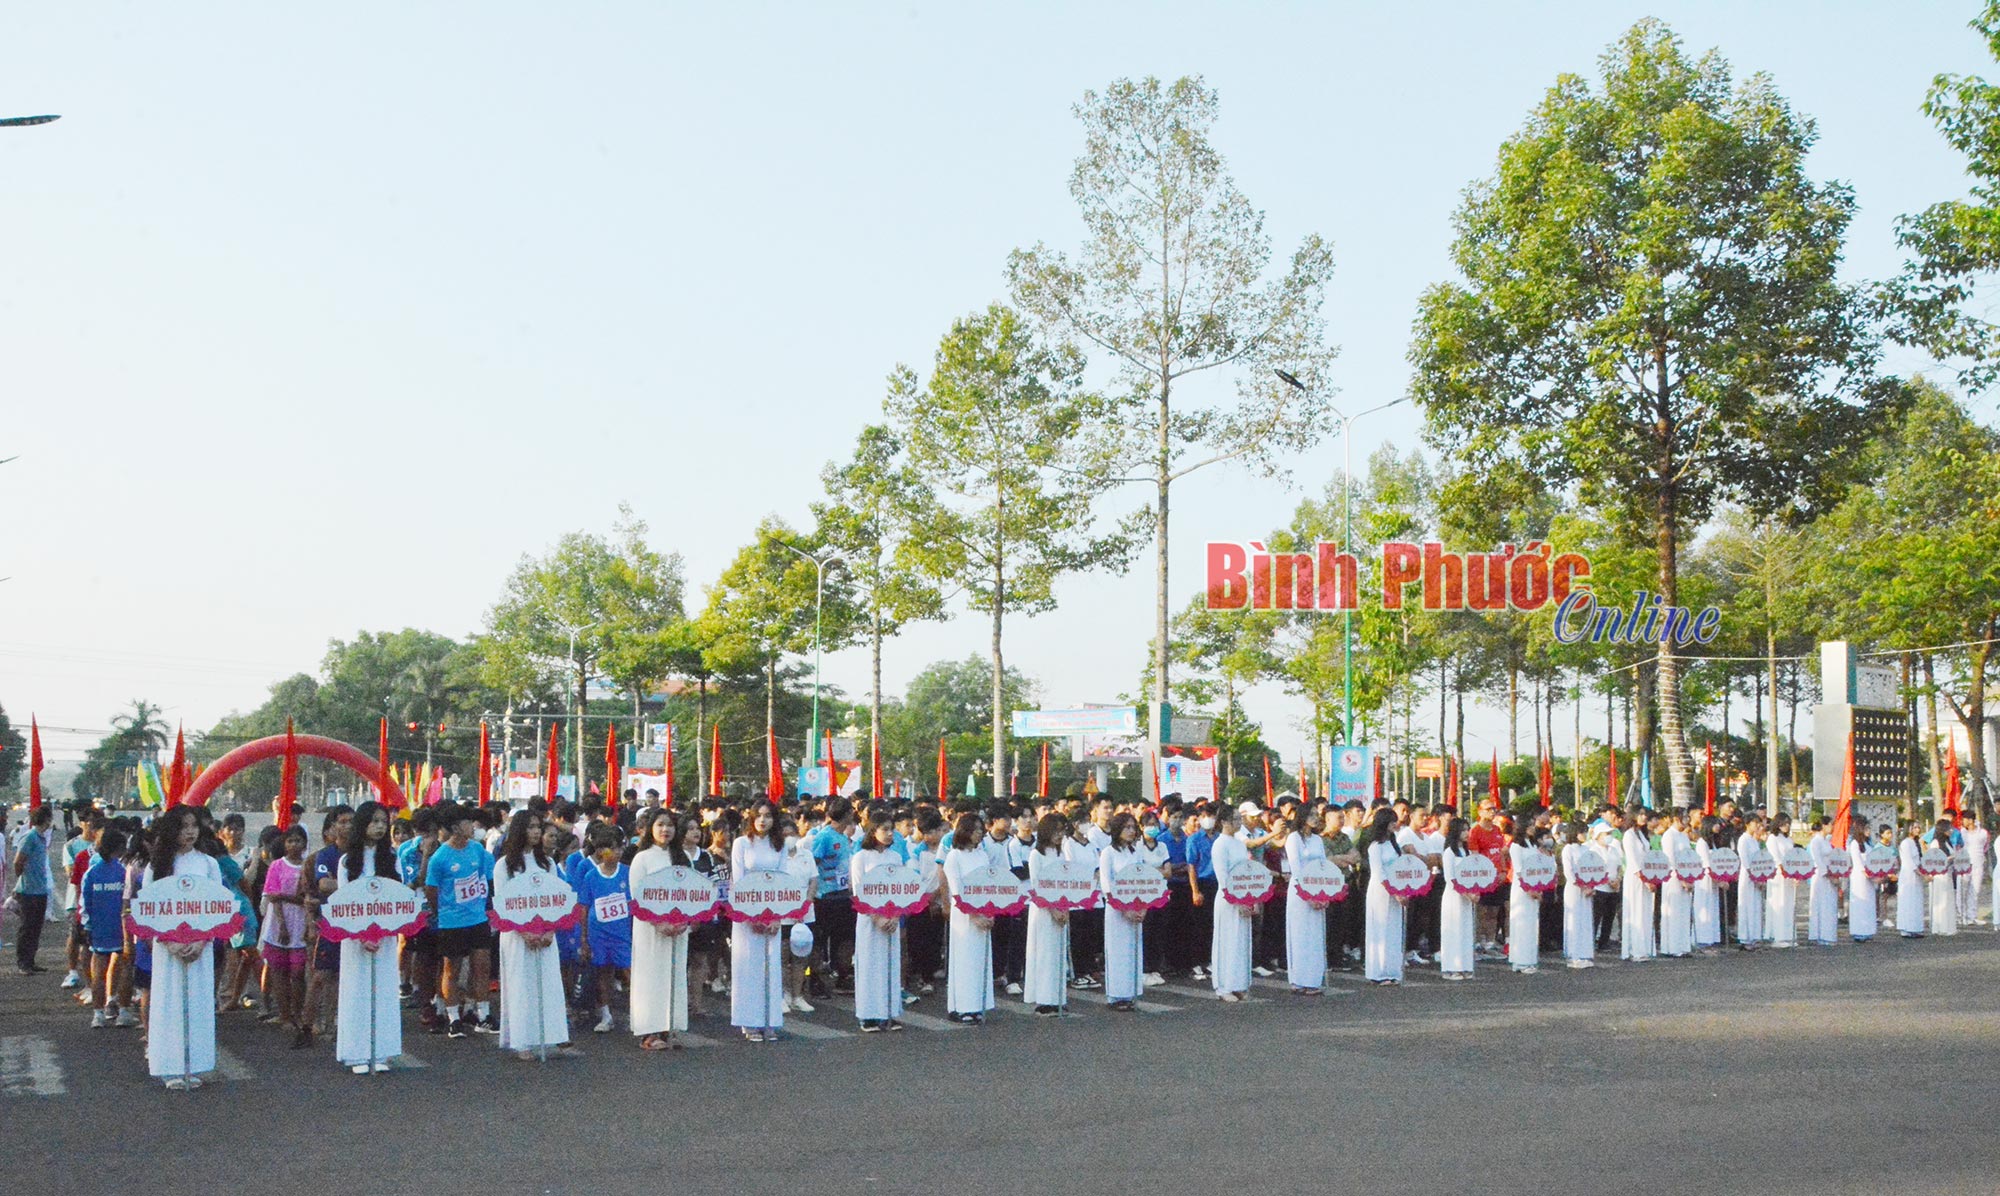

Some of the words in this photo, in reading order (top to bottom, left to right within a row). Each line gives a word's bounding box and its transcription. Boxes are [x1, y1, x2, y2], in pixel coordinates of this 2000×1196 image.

[643, 886, 669, 903] HUYỆN
[735, 888, 762, 905] HUYỆN
[777, 887, 801, 902] ĐĂNG
[863, 881, 889, 898] HUYỆN
[904, 880, 920, 895] ĐỐP
[139, 902, 155, 918] THỊ
[159, 899, 173, 915] XÃ
[176, 898, 201, 914] BÌNH
[204, 901, 231, 914] LONG
[331, 901, 364, 920] HUYỆN
[367, 898, 393, 916] ĐỒNG
[396, 897, 415, 914] PHÚ
[505, 894, 527, 912] HUYỆN
[540, 895, 551, 908] GIA
[601, 903, 627, 920] 181
